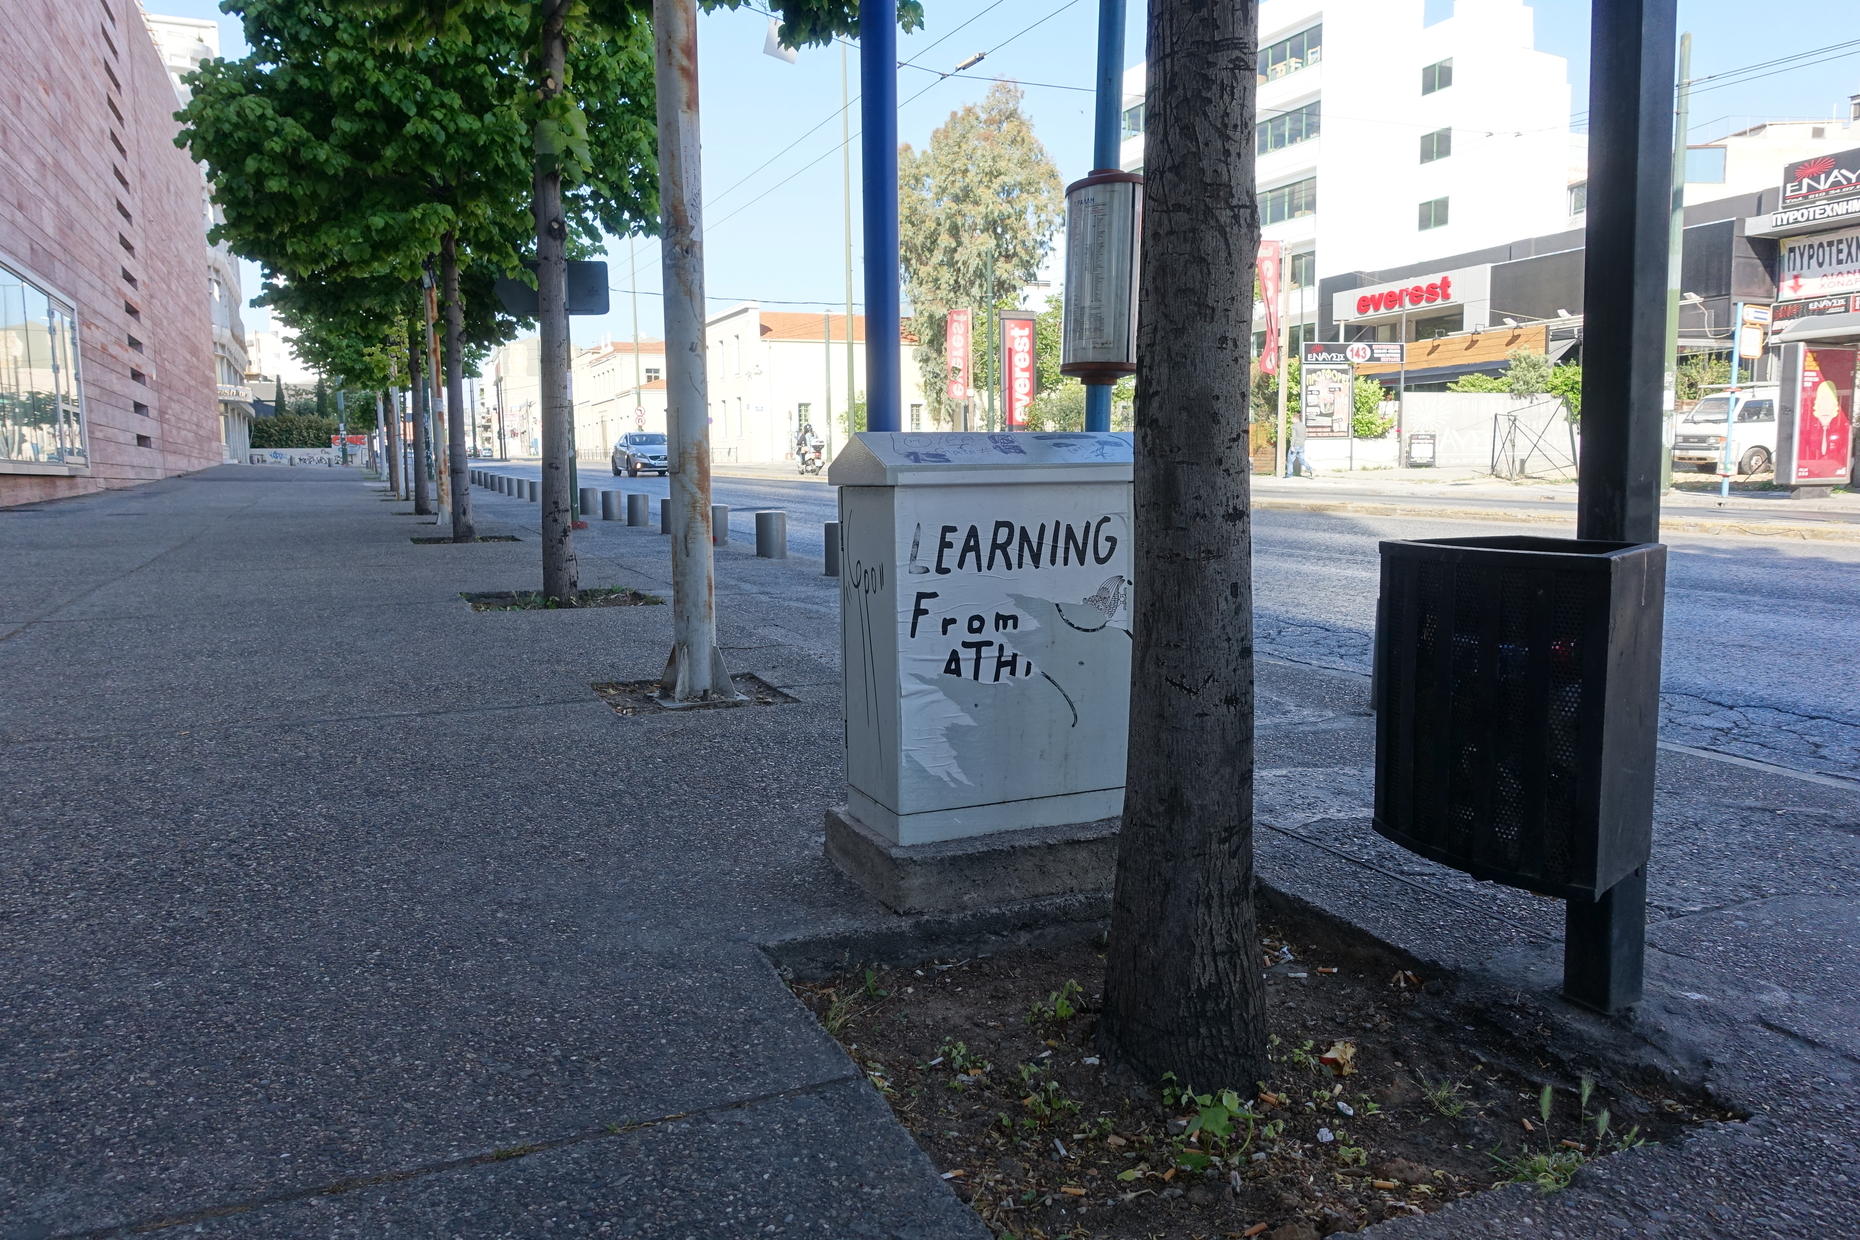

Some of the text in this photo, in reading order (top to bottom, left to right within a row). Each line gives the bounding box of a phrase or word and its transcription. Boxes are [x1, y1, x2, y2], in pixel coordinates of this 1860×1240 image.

[1356, 275, 1451, 314] everest
[1010, 326, 1030, 423] everest
[1350, 346, 1367, 360] 143
[908, 516, 1118, 575] LEARNING
[910, 591, 1019, 639] From
[943, 640, 1033, 683] ATH
